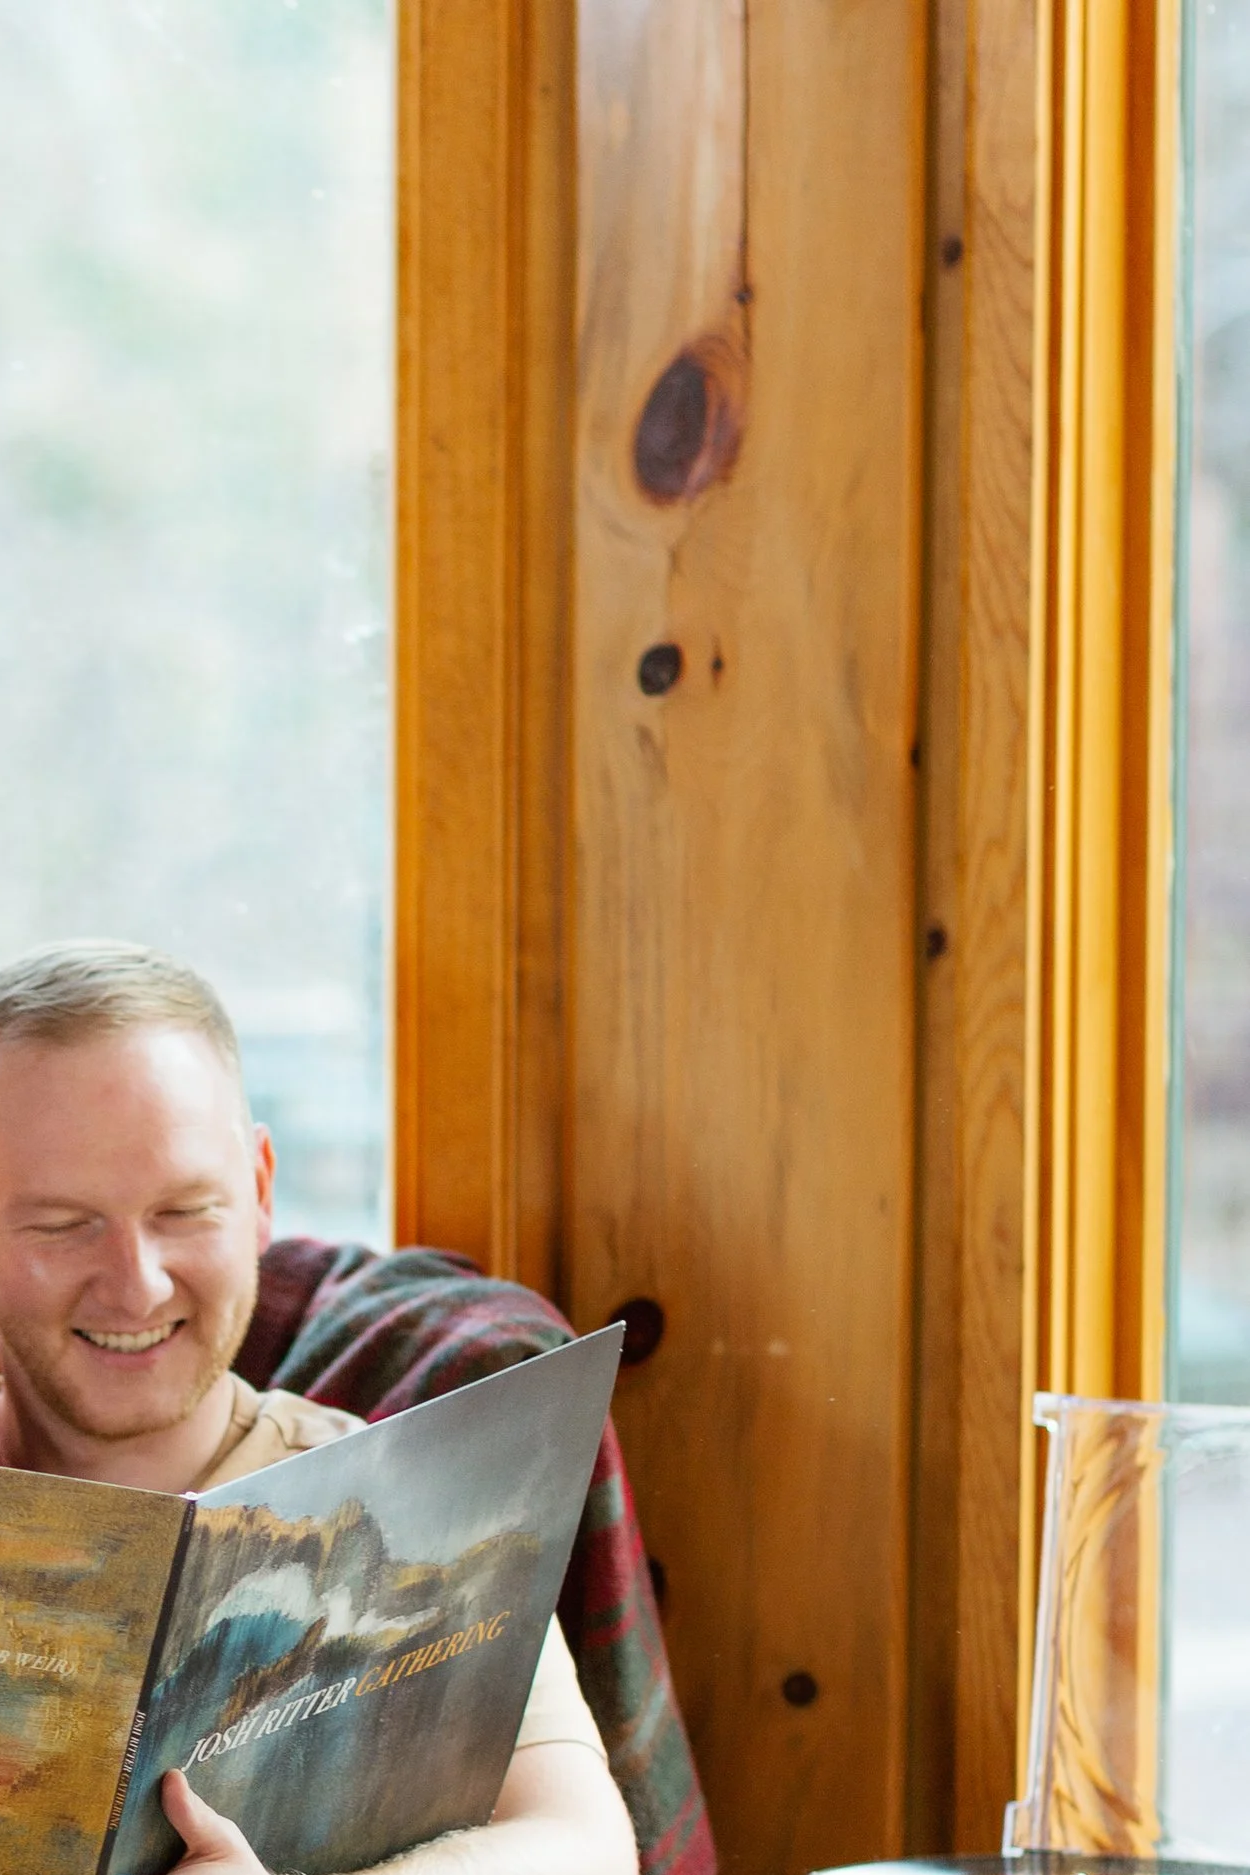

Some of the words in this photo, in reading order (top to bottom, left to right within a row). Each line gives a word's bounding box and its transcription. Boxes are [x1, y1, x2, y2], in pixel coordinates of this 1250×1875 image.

[14, 1652, 77, 1677] WEIR)
[180, 1717, 256, 1772] JOSH
[253, 1677, 357, 1740] RITTER
[354, 1611, 511, 1697] GATHERING
